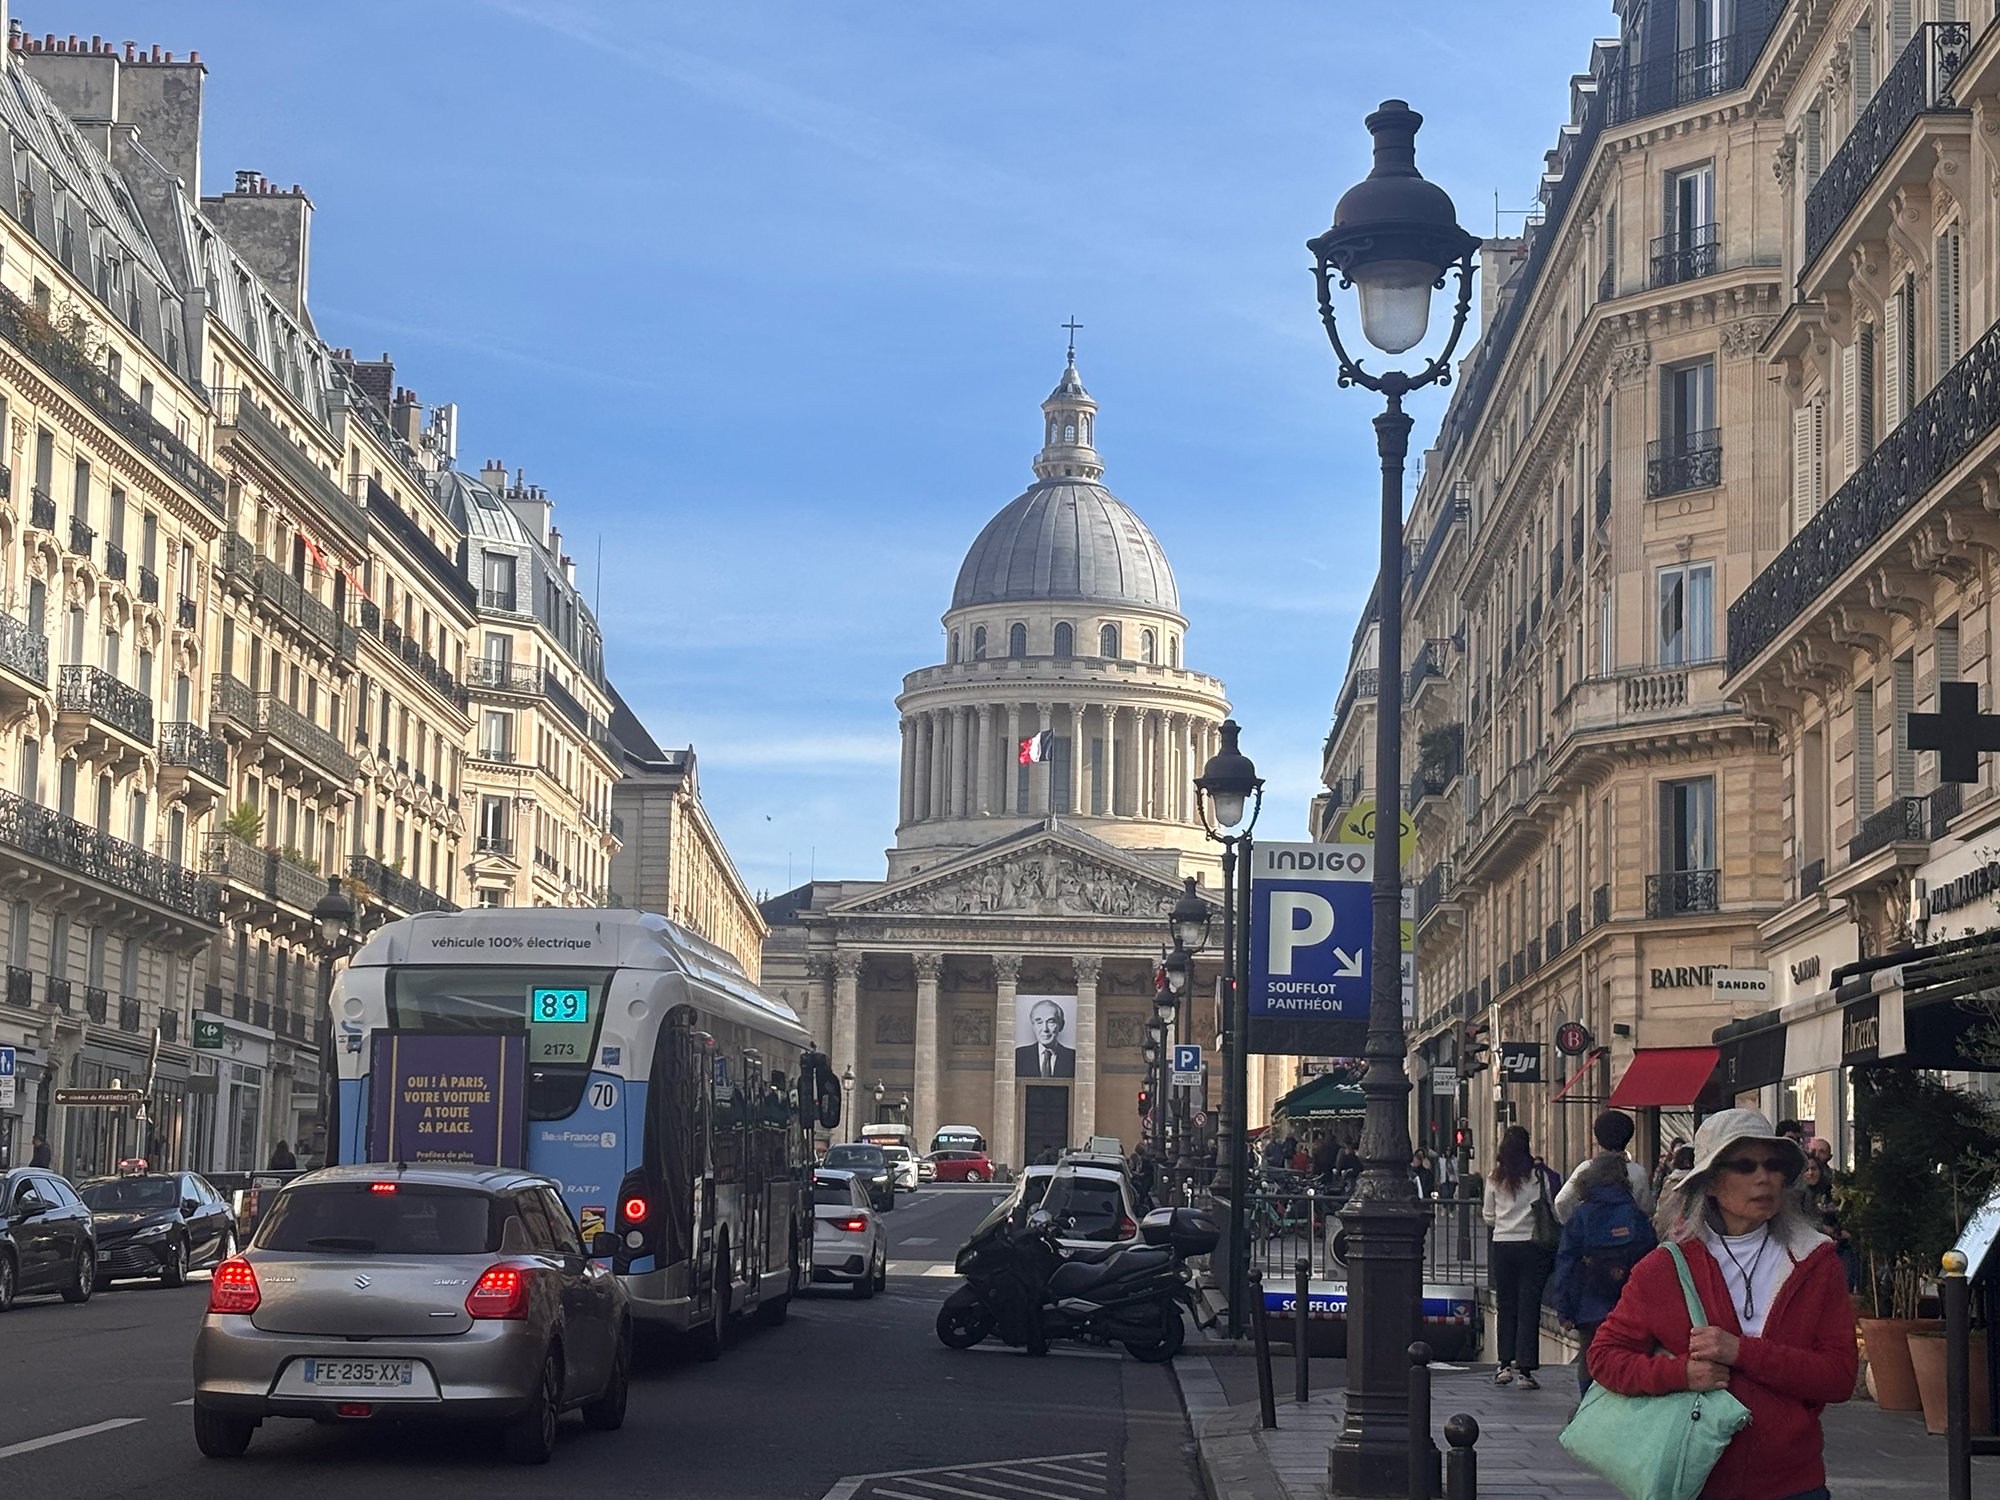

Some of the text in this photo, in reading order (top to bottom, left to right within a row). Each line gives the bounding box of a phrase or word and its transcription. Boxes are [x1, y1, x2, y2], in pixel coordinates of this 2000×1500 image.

[1268, 890, 1335, 975] P
[431, 936, 592, 950] véhicule 100% électrique
[1650, 963, 1728, 989] BARNE
[1267, 981, 1337, 995] SOUFFLOT
[1717, 980, 1766, 991] SANDRO
[541, 993, 578, 1019] 89
[1267, 995, 1343, 1012] PANTHÉON
[1567, 1031, 1580, 1047] B
[543, 1043, 575, 1056] 2173
[1181, 1050, 1194, 1068] P
[407, 1076, 428, 1088] OUI
[439, 1074, 448, 1088] À
[450, 1076, 488, 1090] PARIS,
[404, 1091, 491, 1103] VOTRE VOITURE
[593, 1084, 613, 1108] 70
[424, 1106, 470, 1118] A TOUTE
[418, 1121, 474, 1133] SA PLACE.
[446, 1151, 457, 1159] de
[458, 1151, 474, 1161] plus
[566, 1184, 600, 1194] RATP
[1282, 1300, 1347, 1313] SOFFLOT
[315, 1362, 401, 1381] FE-235-XX
